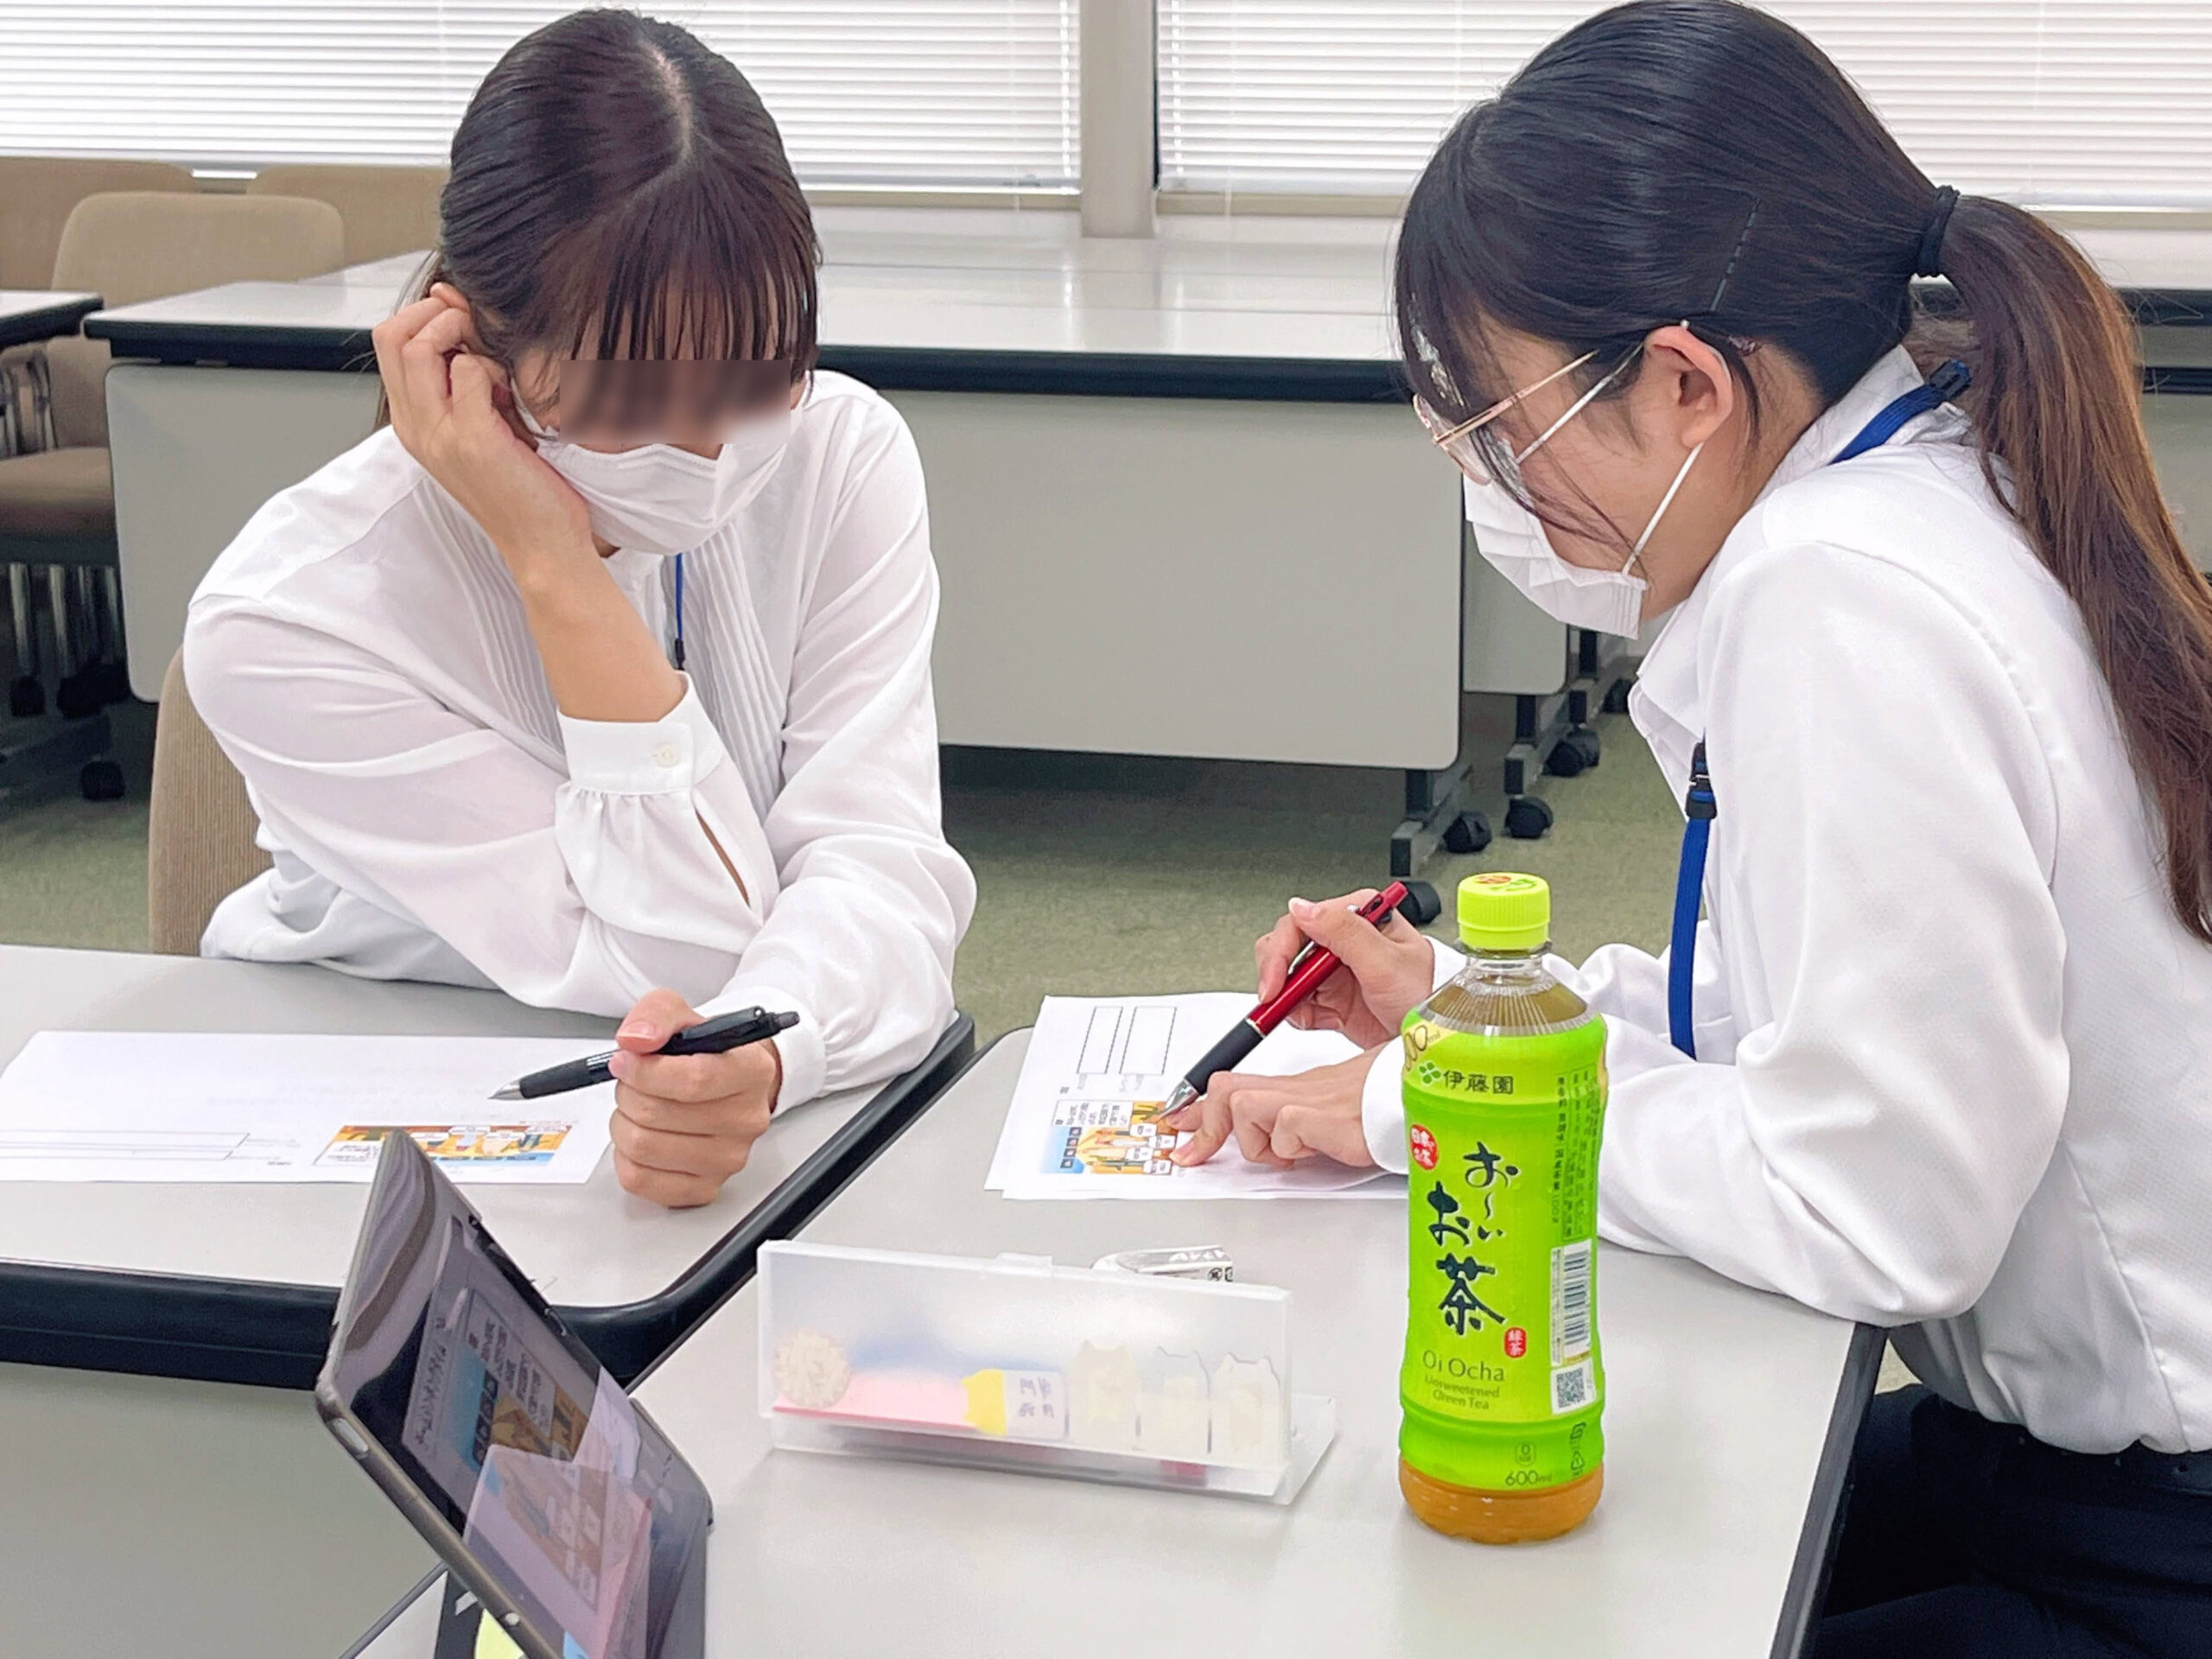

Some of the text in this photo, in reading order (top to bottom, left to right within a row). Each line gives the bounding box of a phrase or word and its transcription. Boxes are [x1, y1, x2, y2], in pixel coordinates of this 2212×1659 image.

[1443, 1070, 1514, 1095] 伊藤園
[1423, 1350, 1504, 1382] Oi Ocha
[1424, 1374, 1500, 1398] Unsweetened
[1469, 1397, 1490, 1410] Tea
